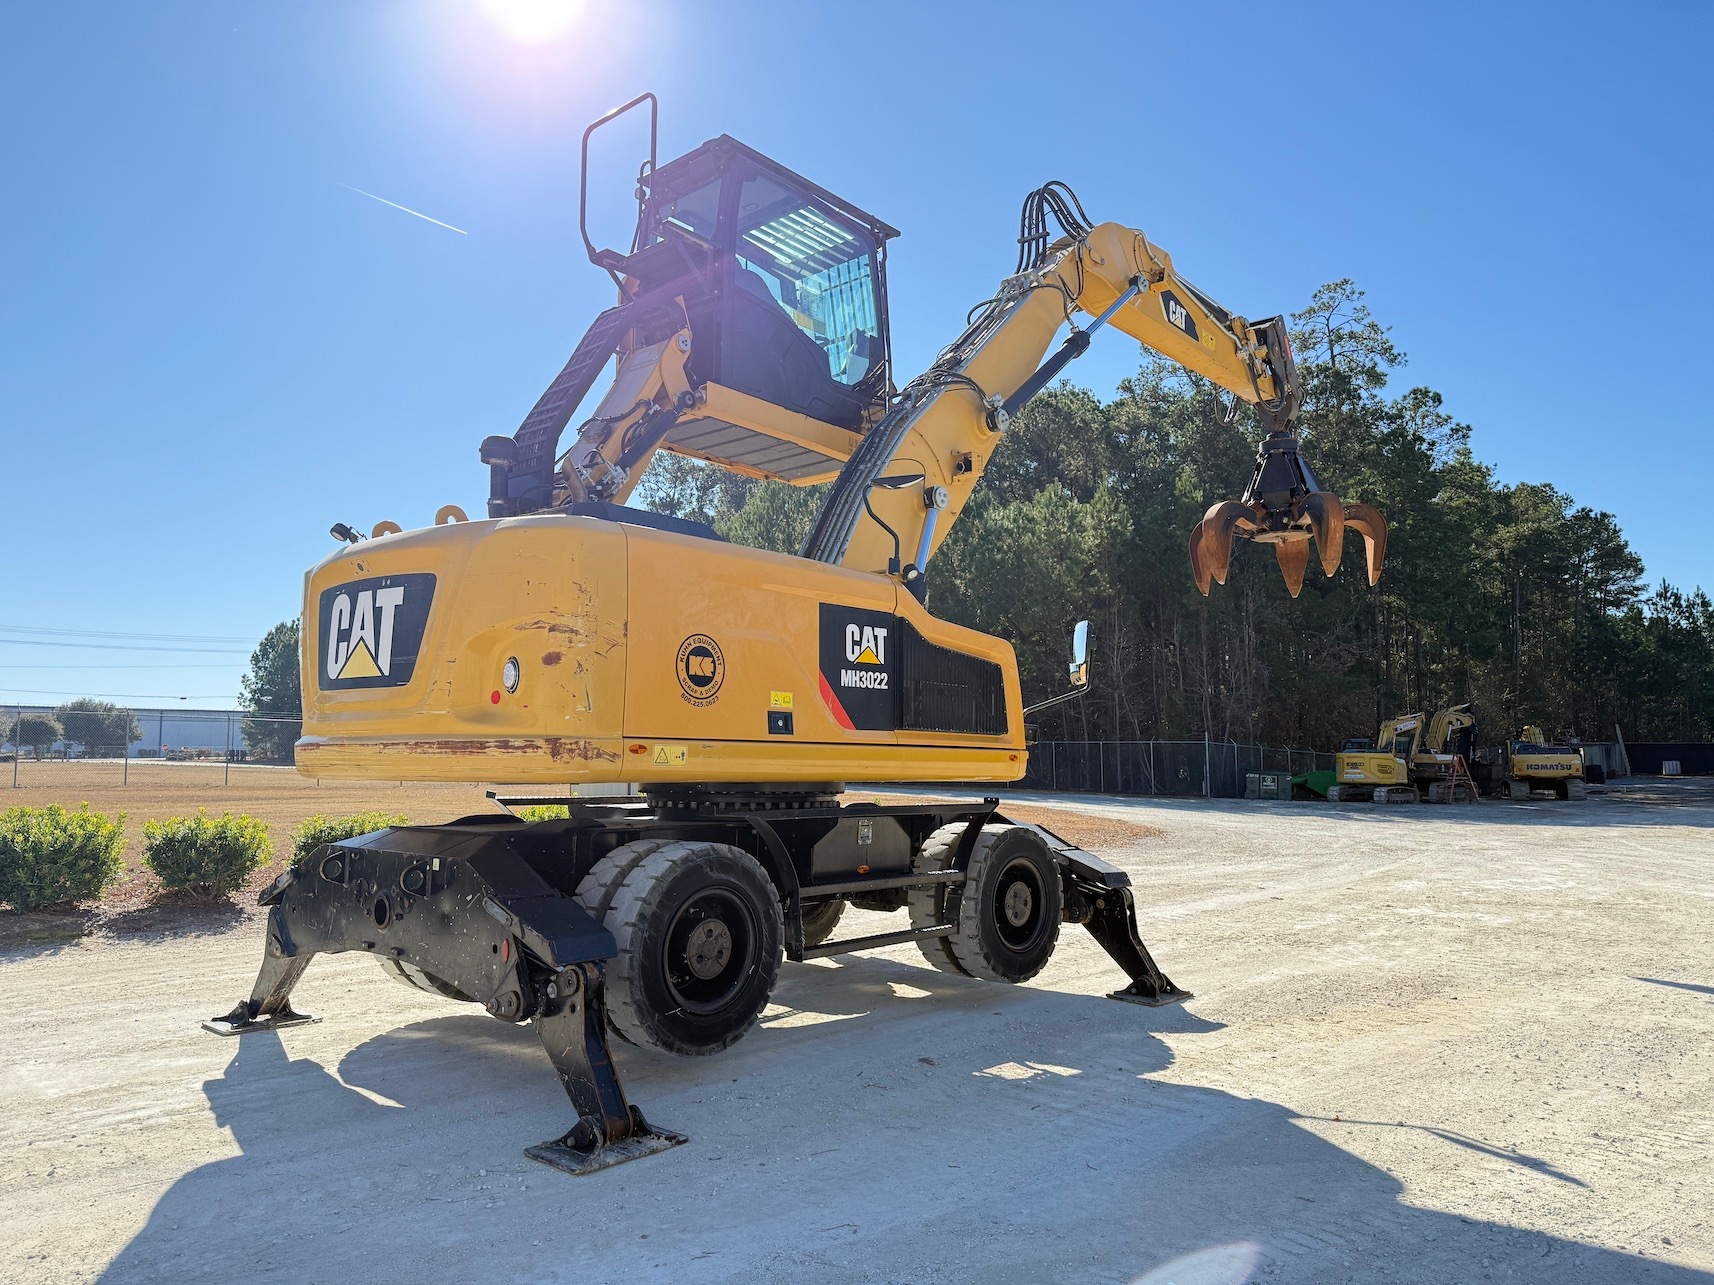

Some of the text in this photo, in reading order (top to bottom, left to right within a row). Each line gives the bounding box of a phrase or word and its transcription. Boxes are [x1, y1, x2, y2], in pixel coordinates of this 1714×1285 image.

[1169, 300, 1186, 330] CAT
[327, 586, 404, 680] CAT
[845, 623, 887, 665] CAT
[680, 638, 722, 666] KUHN EQUIPMENT
[682, 677, 698, 694] SCRAP
[841, 669, 888, 690] MH3022
[1526, 762, 1572, 771] KOMATSU
